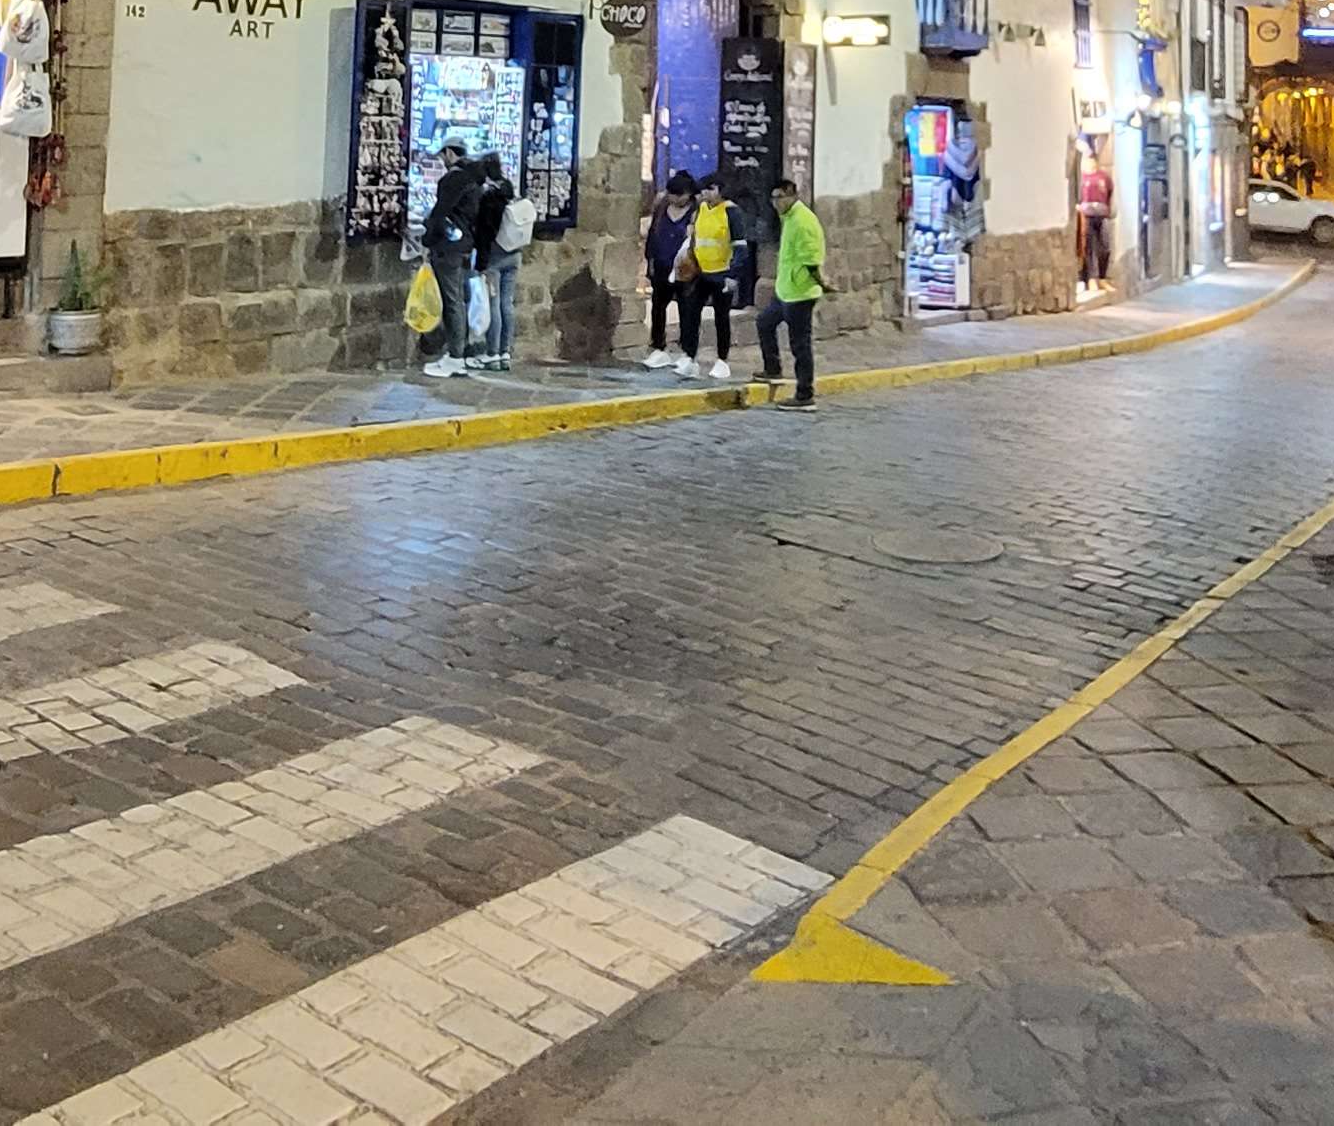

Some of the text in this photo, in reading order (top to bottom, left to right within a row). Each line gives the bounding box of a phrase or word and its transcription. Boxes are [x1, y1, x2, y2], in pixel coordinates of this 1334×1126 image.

[125, 4, 146, 18] 142
[601, 4, 647, 24] CHOCO
[229, 19, 275, 39] ART
